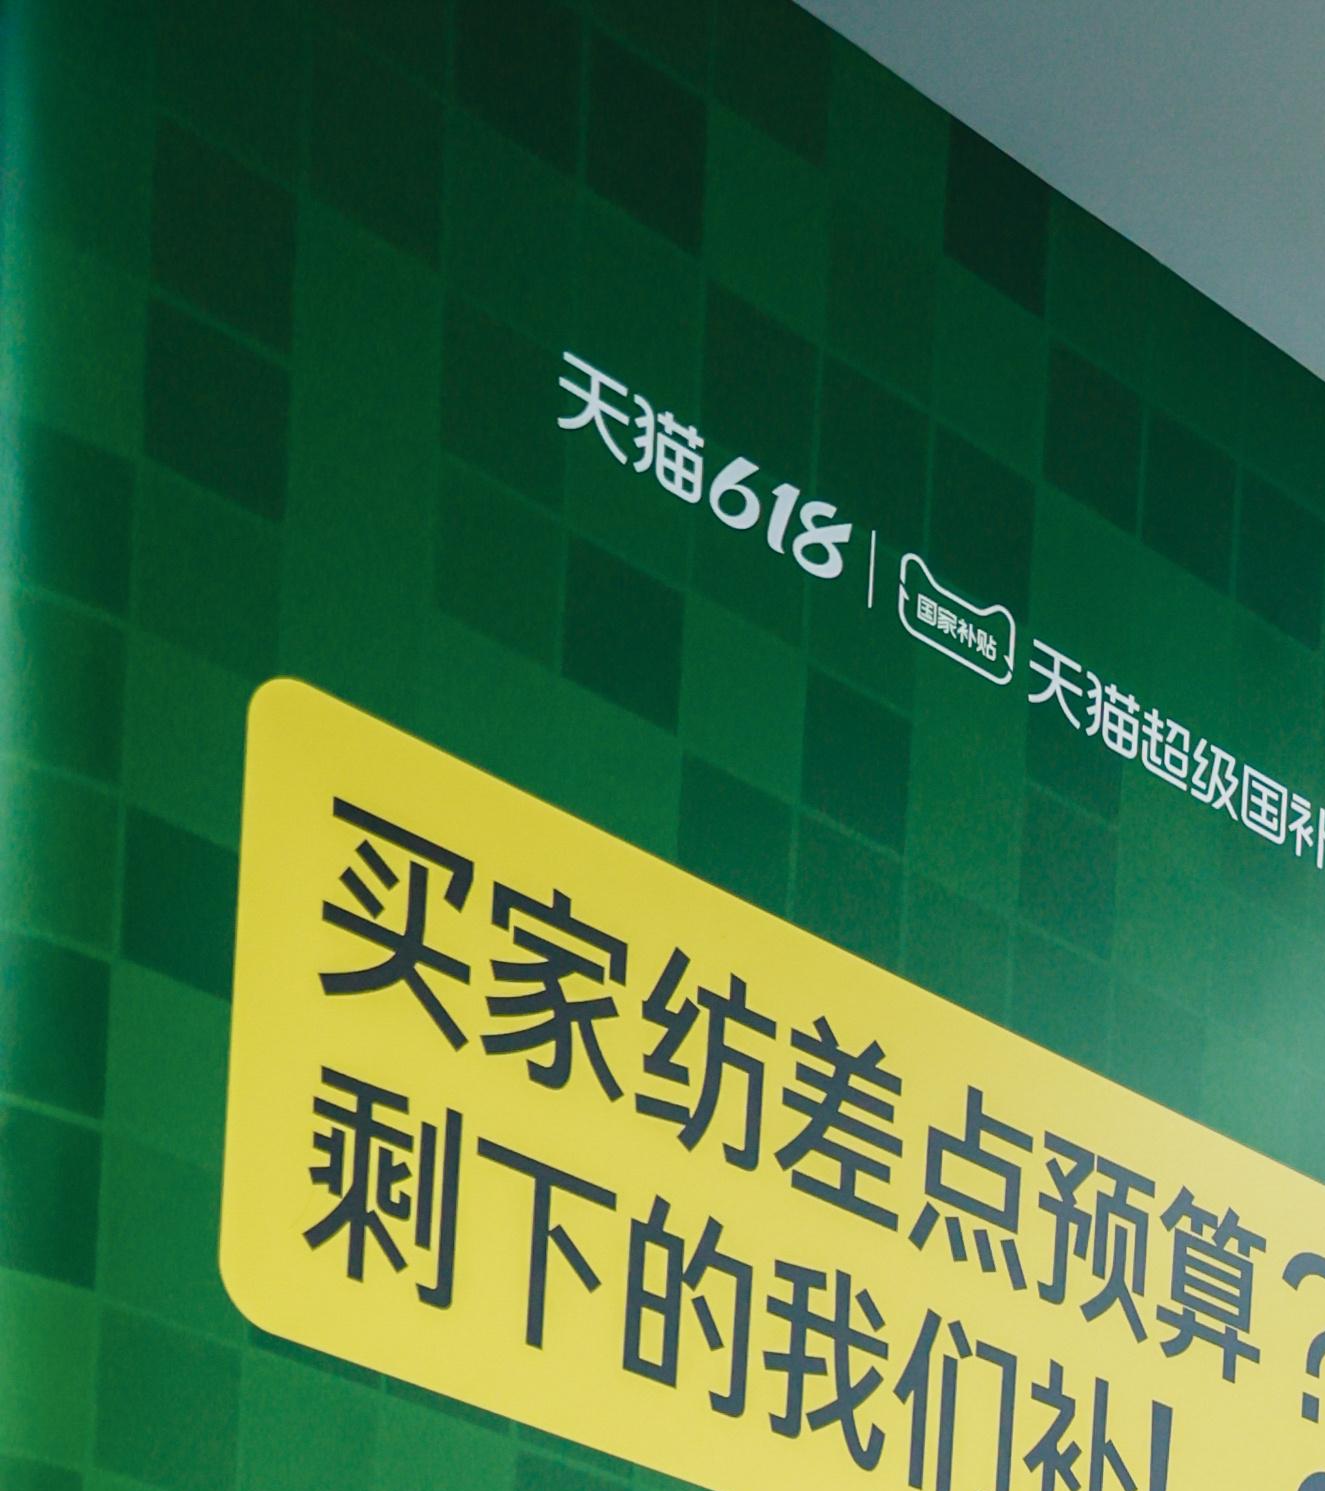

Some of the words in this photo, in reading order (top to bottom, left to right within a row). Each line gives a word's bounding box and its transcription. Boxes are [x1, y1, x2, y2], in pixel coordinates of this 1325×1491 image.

[558, 352, 854, 580] 天猫618
[916, 593, 997, 662] 国家补贴
